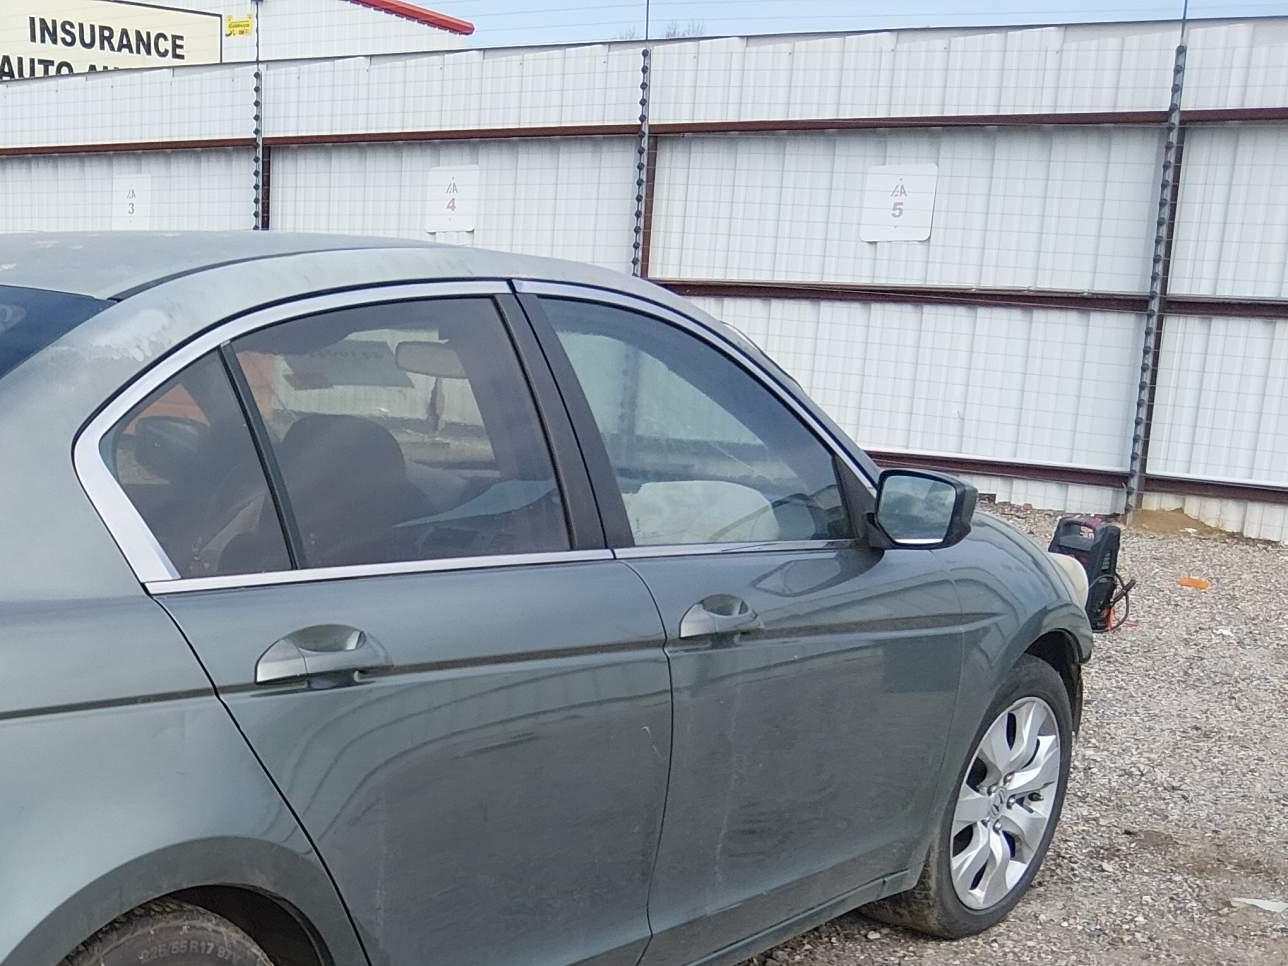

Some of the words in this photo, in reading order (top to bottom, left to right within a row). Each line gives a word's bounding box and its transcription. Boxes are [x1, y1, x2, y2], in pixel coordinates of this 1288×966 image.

[28, 15, 185, 60] INSURANCE
[128, 202, 135, 215] 3
[446, 198, 456, 211] 4
[891, 202, 904, 218] 5
